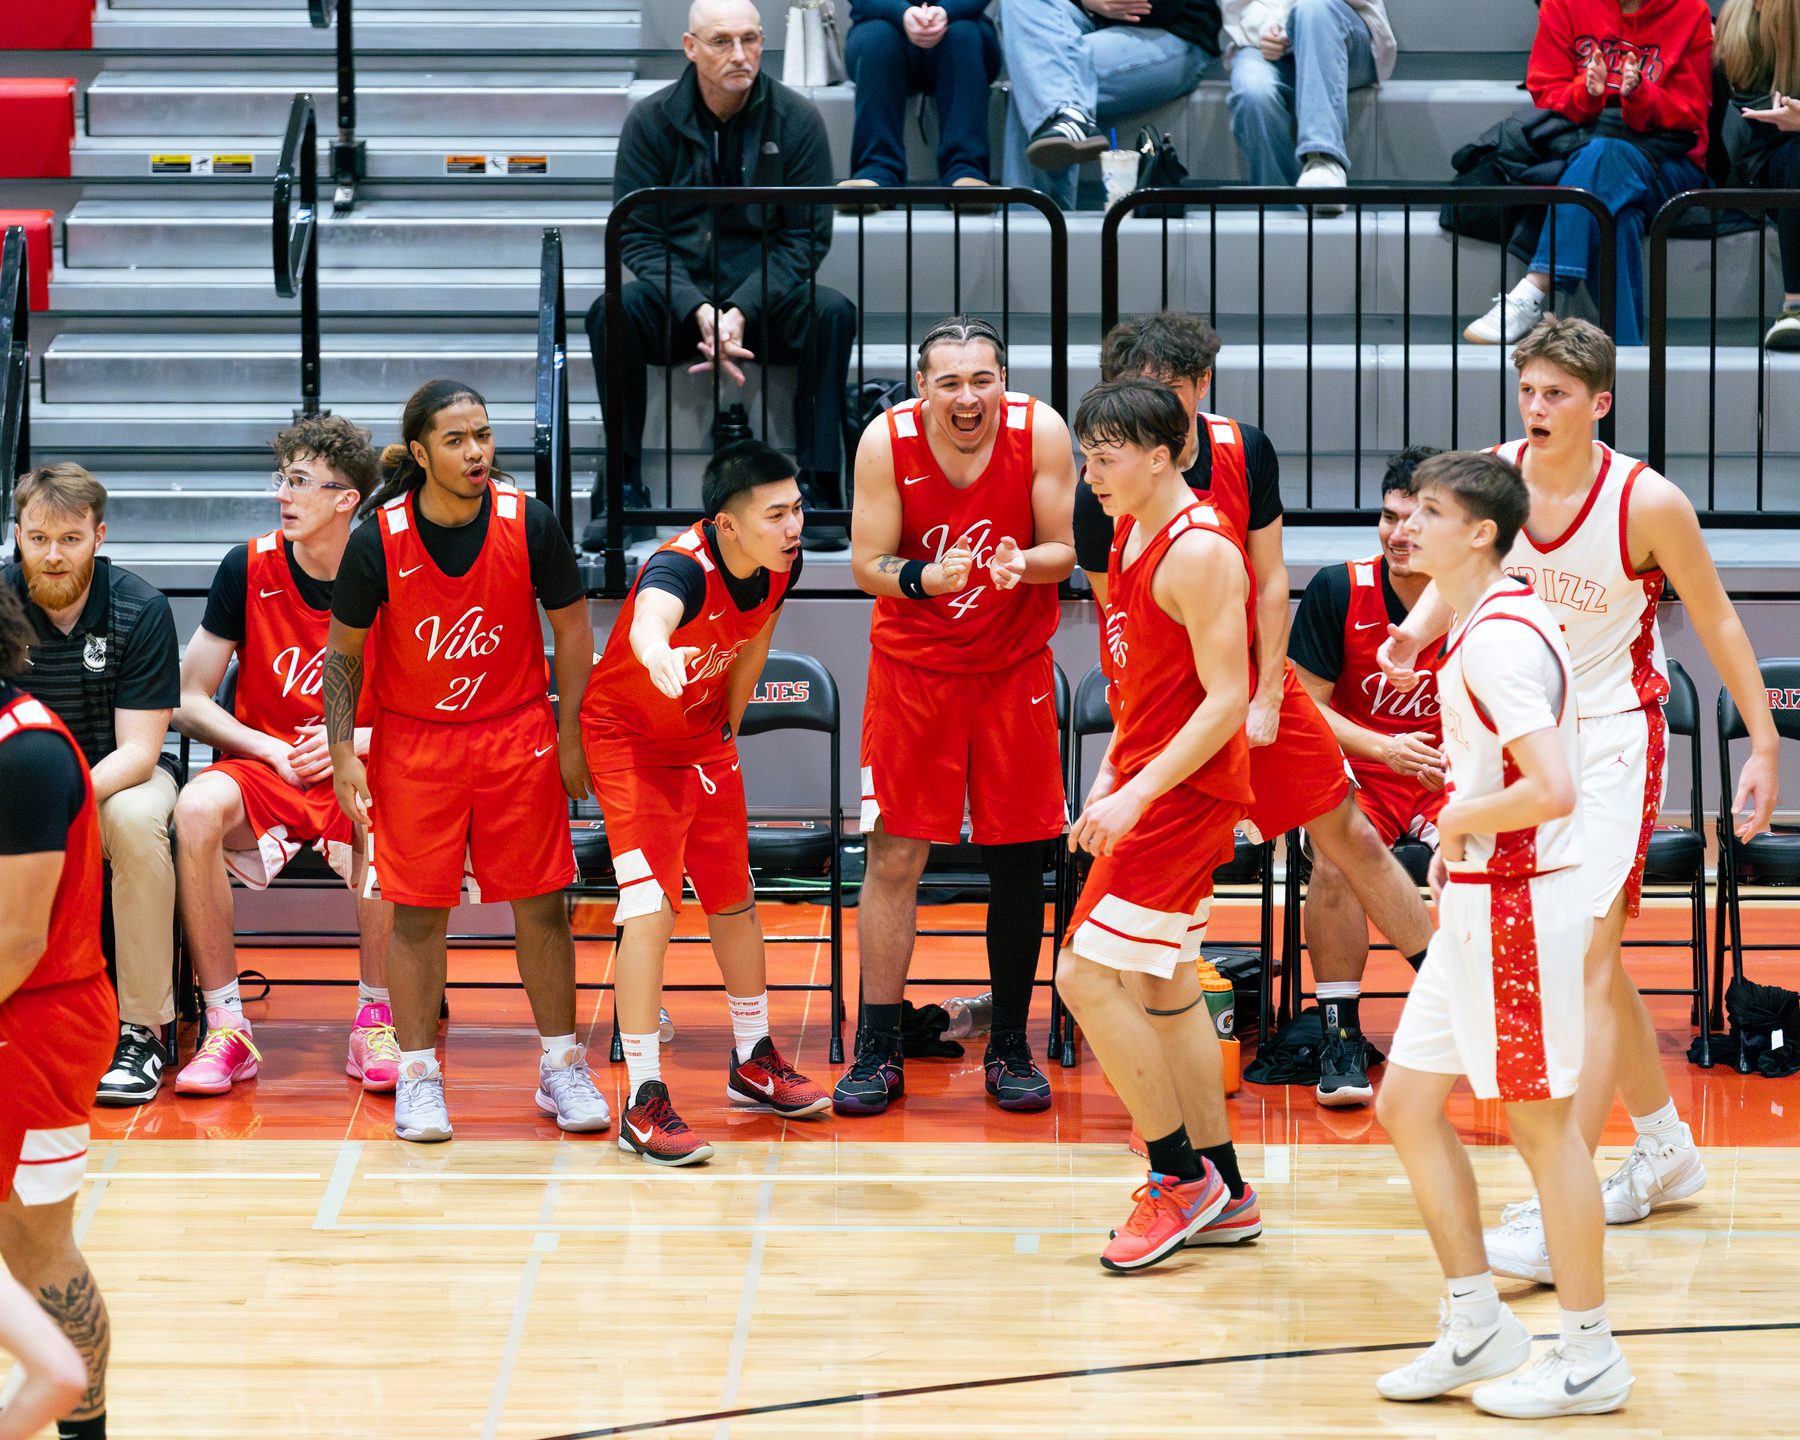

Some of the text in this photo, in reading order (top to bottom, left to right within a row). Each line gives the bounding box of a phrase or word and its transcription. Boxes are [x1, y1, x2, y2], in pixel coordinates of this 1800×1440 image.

[921, 518, 997, 570] Vk
[947, 585, 987, 620] 4
[414, 606, 504, 662] Viks
[272, 646, 328, 698] Vi
[434, 671, 488, 712] 21
[748, 681, 810, 704] LIES
[1765, 687, 1800, 710] RI
